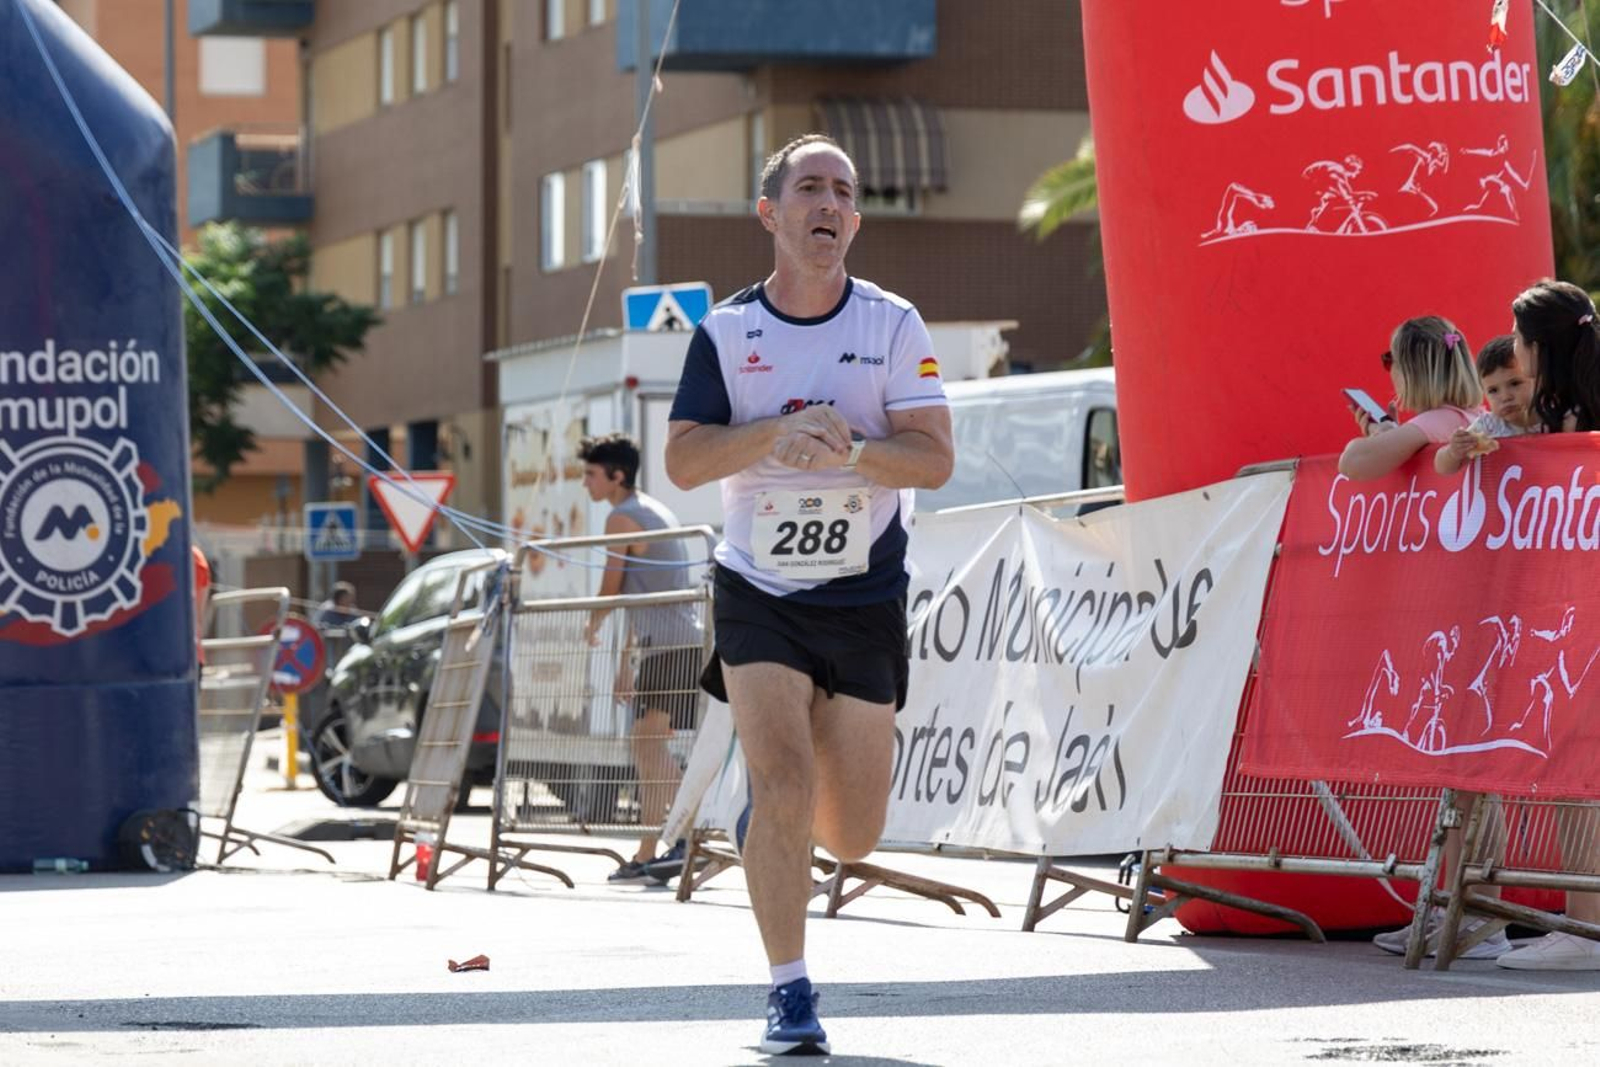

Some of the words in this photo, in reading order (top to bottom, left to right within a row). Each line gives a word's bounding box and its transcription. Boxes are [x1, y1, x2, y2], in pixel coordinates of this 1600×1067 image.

[1266, 50, 1530, 115] Santander
[0, 338, 160, 384] ndación
[0, 385, 128, 439] mupol
[770, 518, 850, 556] 288
[1318, 472, 1437, 578] Sports
[1485, 464, 1600, 551] Santa
[35, 569, 100, 591] POLICÍA
